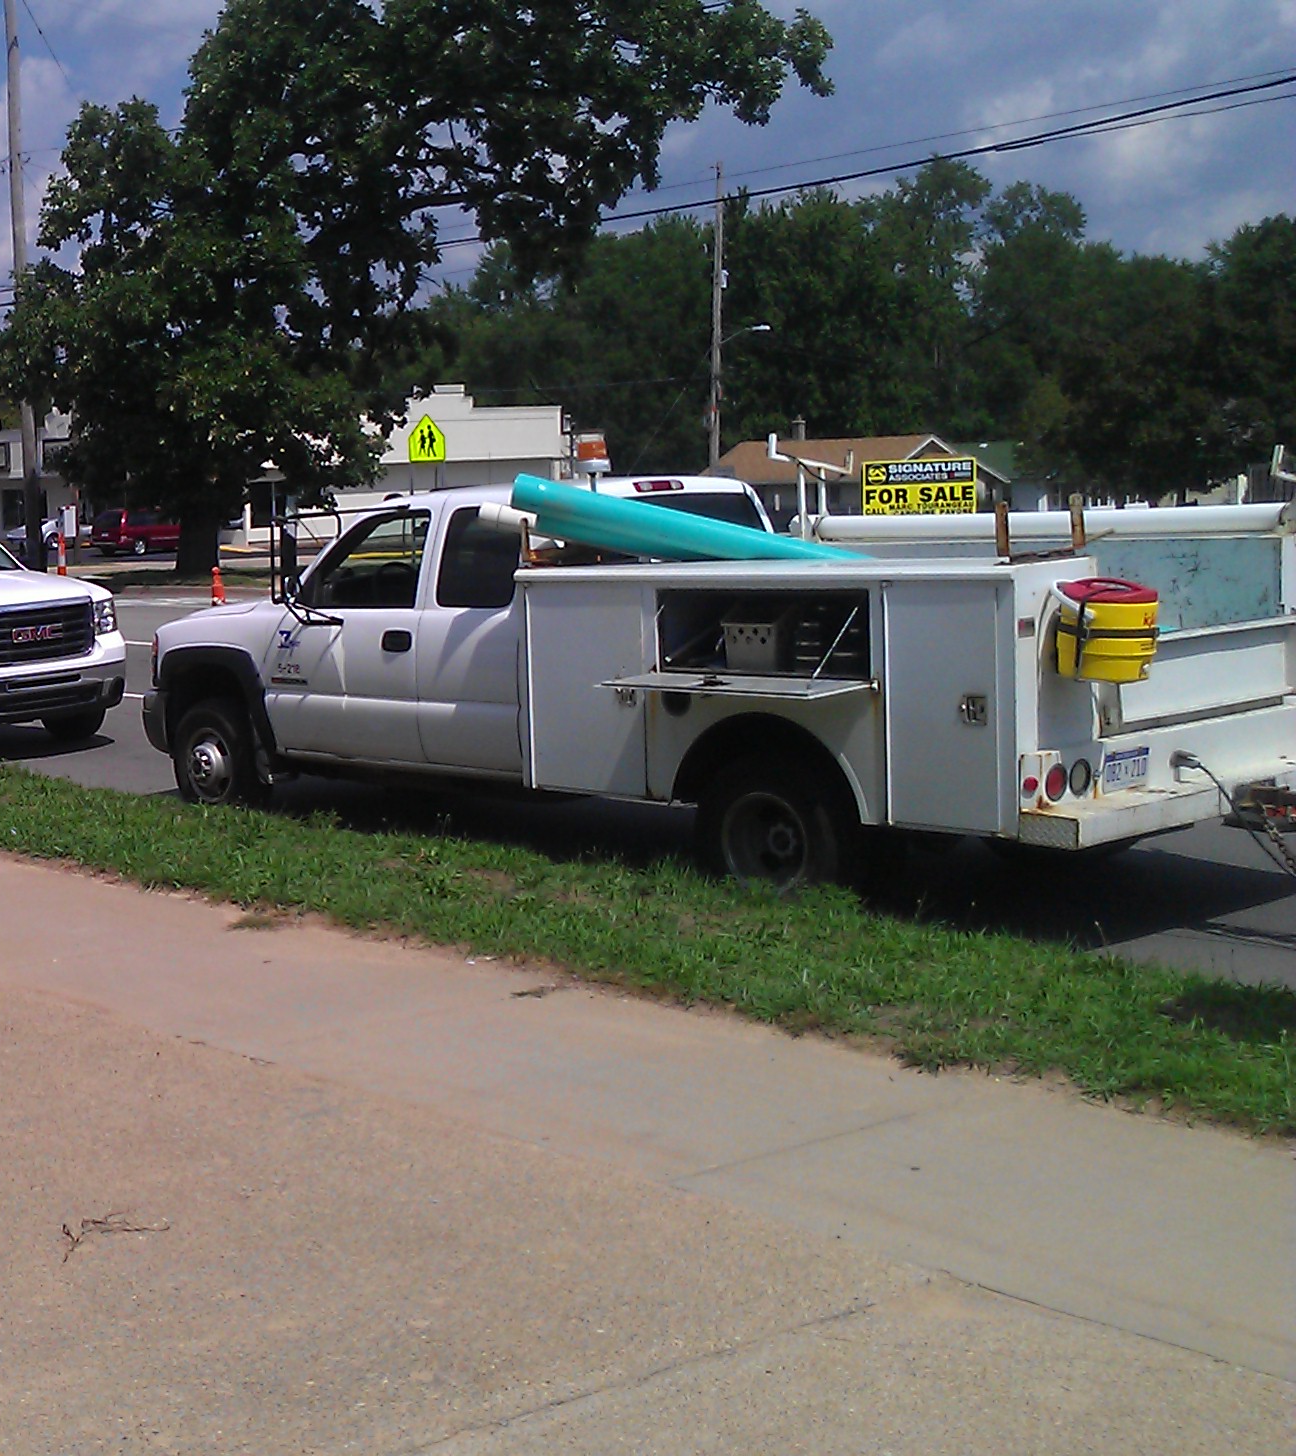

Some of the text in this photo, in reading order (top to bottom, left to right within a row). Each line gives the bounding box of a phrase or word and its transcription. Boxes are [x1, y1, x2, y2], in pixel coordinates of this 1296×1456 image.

[888, 462, 972, 473] SIGNATURE
[888, 473, 948, 482] ASSOCIATES
[865, 485, 974, 505] FOR SALE
[12, 623, 63, 643] GMC
